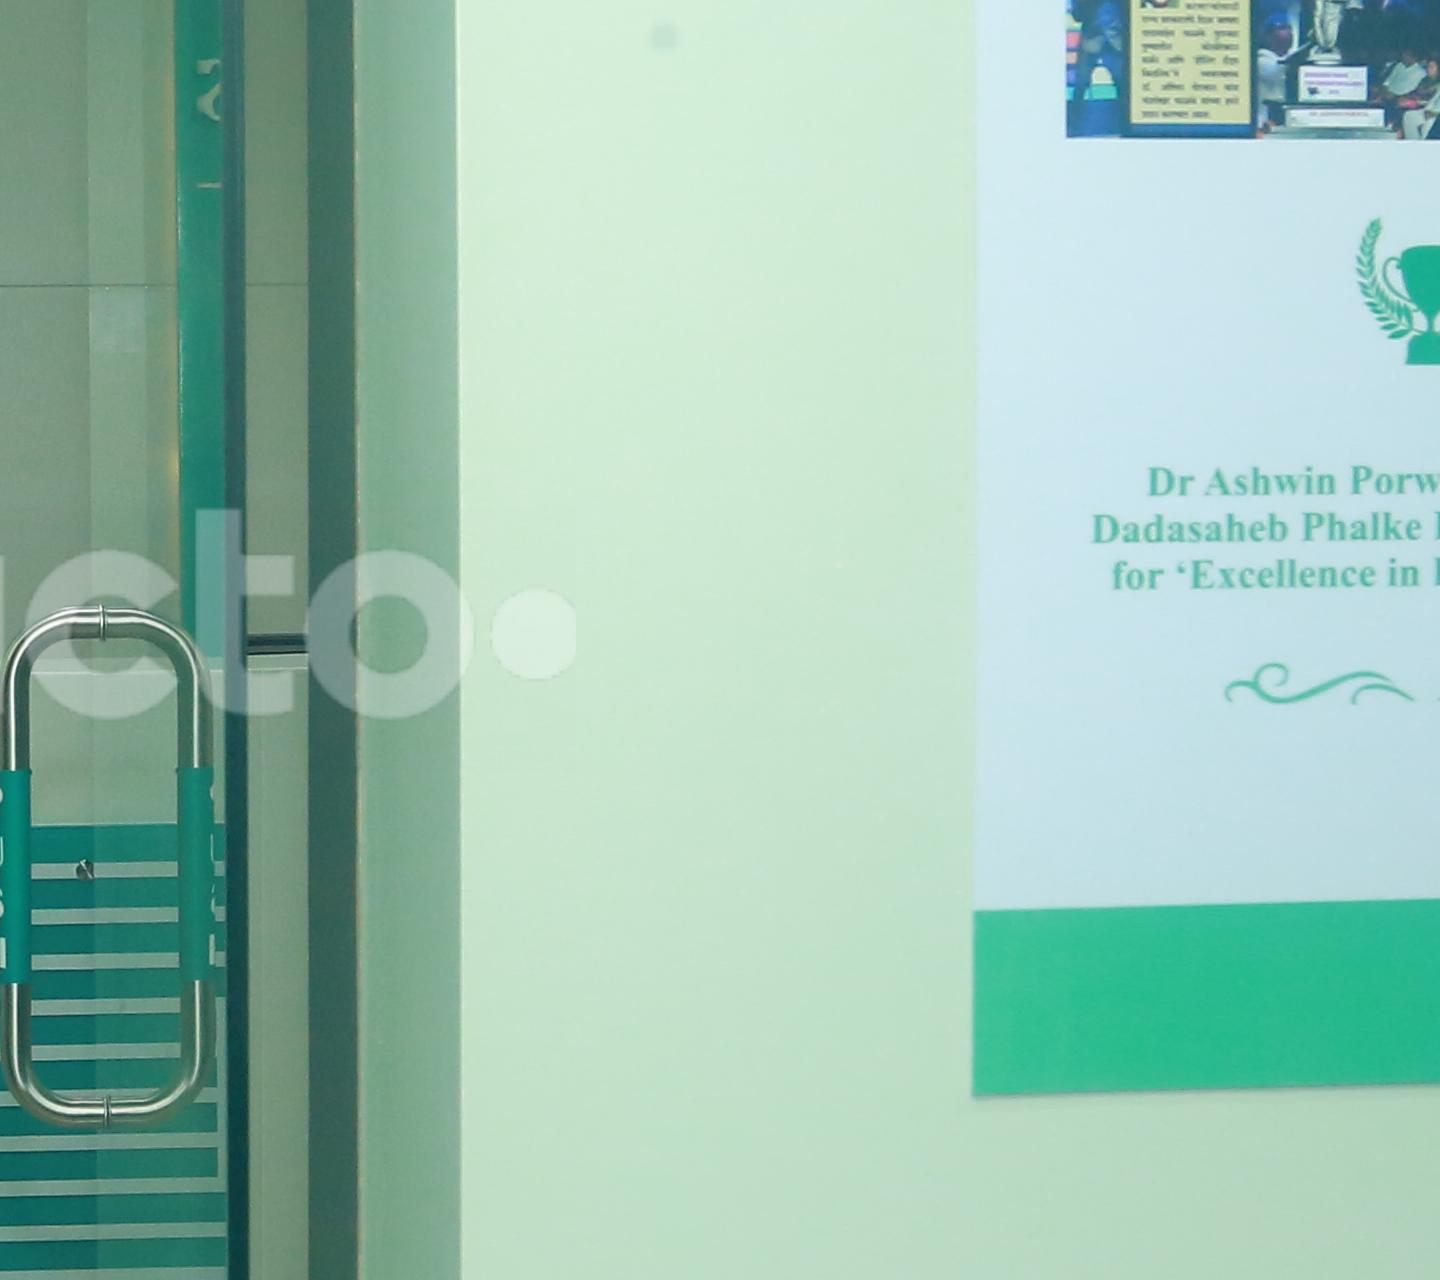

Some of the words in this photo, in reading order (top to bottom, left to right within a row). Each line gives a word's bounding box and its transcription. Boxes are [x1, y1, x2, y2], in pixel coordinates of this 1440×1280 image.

[1149, 467, 1195, 496] Dr
[1205, 466, 1336, 496] Ashwin
[1093, 513, 1289, 543] Dadasaheb
[1303, 512, 1422, 541] Phalke
[1113, 561, 1165, 590] for
[1177, 558, 1376, 589] ‘Excellence
[1389, 558, 1419, 587] in
